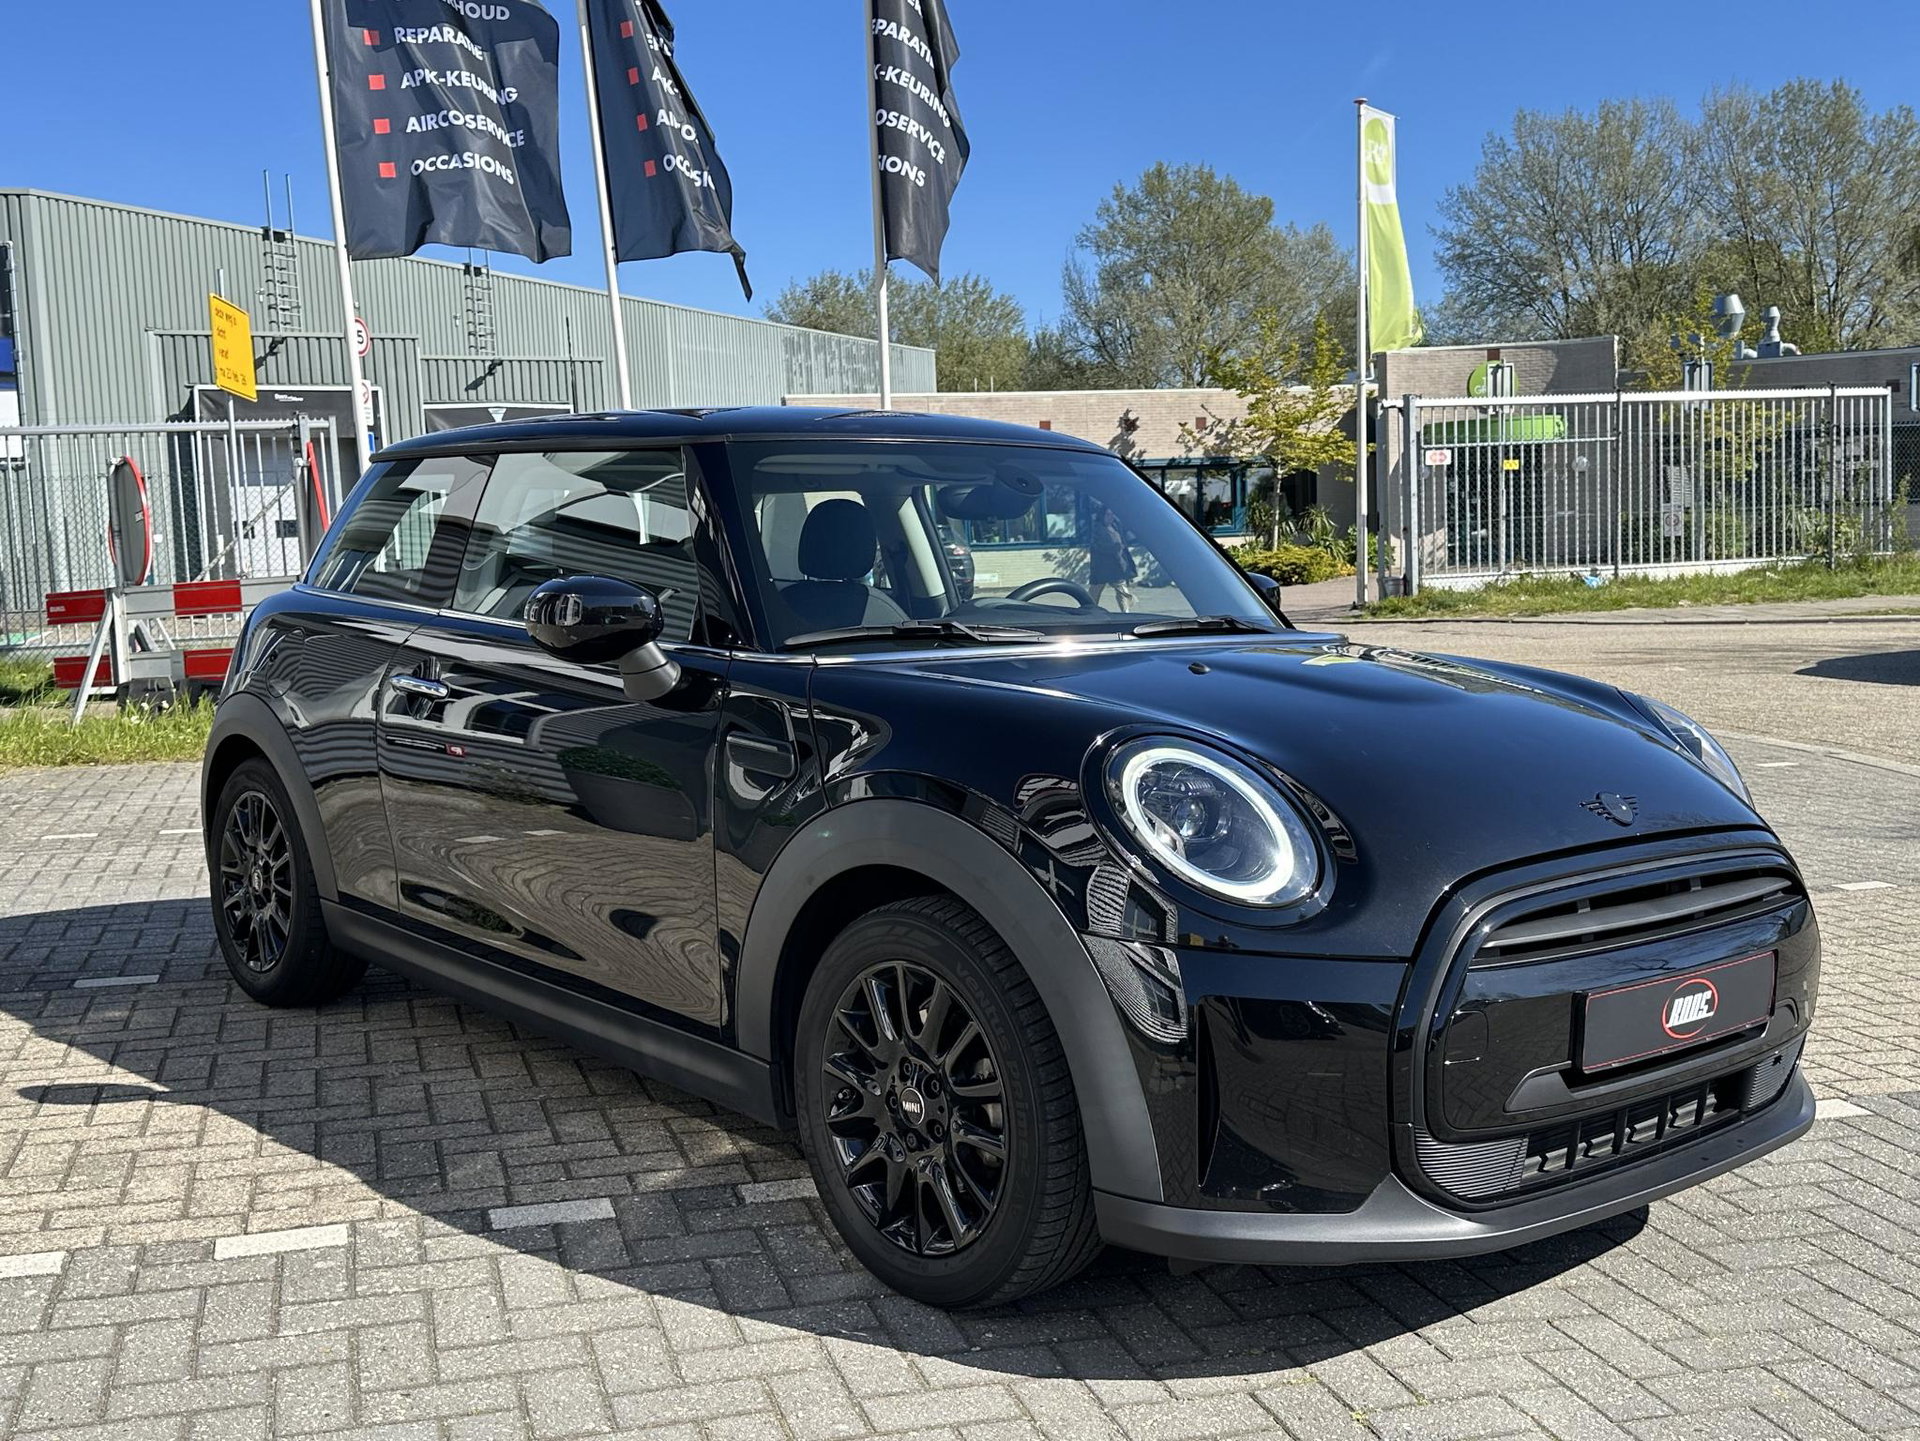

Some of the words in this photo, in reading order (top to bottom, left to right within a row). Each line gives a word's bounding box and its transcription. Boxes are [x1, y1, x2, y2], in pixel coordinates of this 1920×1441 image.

[447, 0, 511, 20] HOUD
[393, 26, 484, 61] REPARATIE
[400, 68, 519, 105] APK-KEURING
[405, 110, 525, 148] AIRCOSERVICE
[410, 151, 514, 185] OCCASIONS
[902, 1100, 921, 1114] MINI
